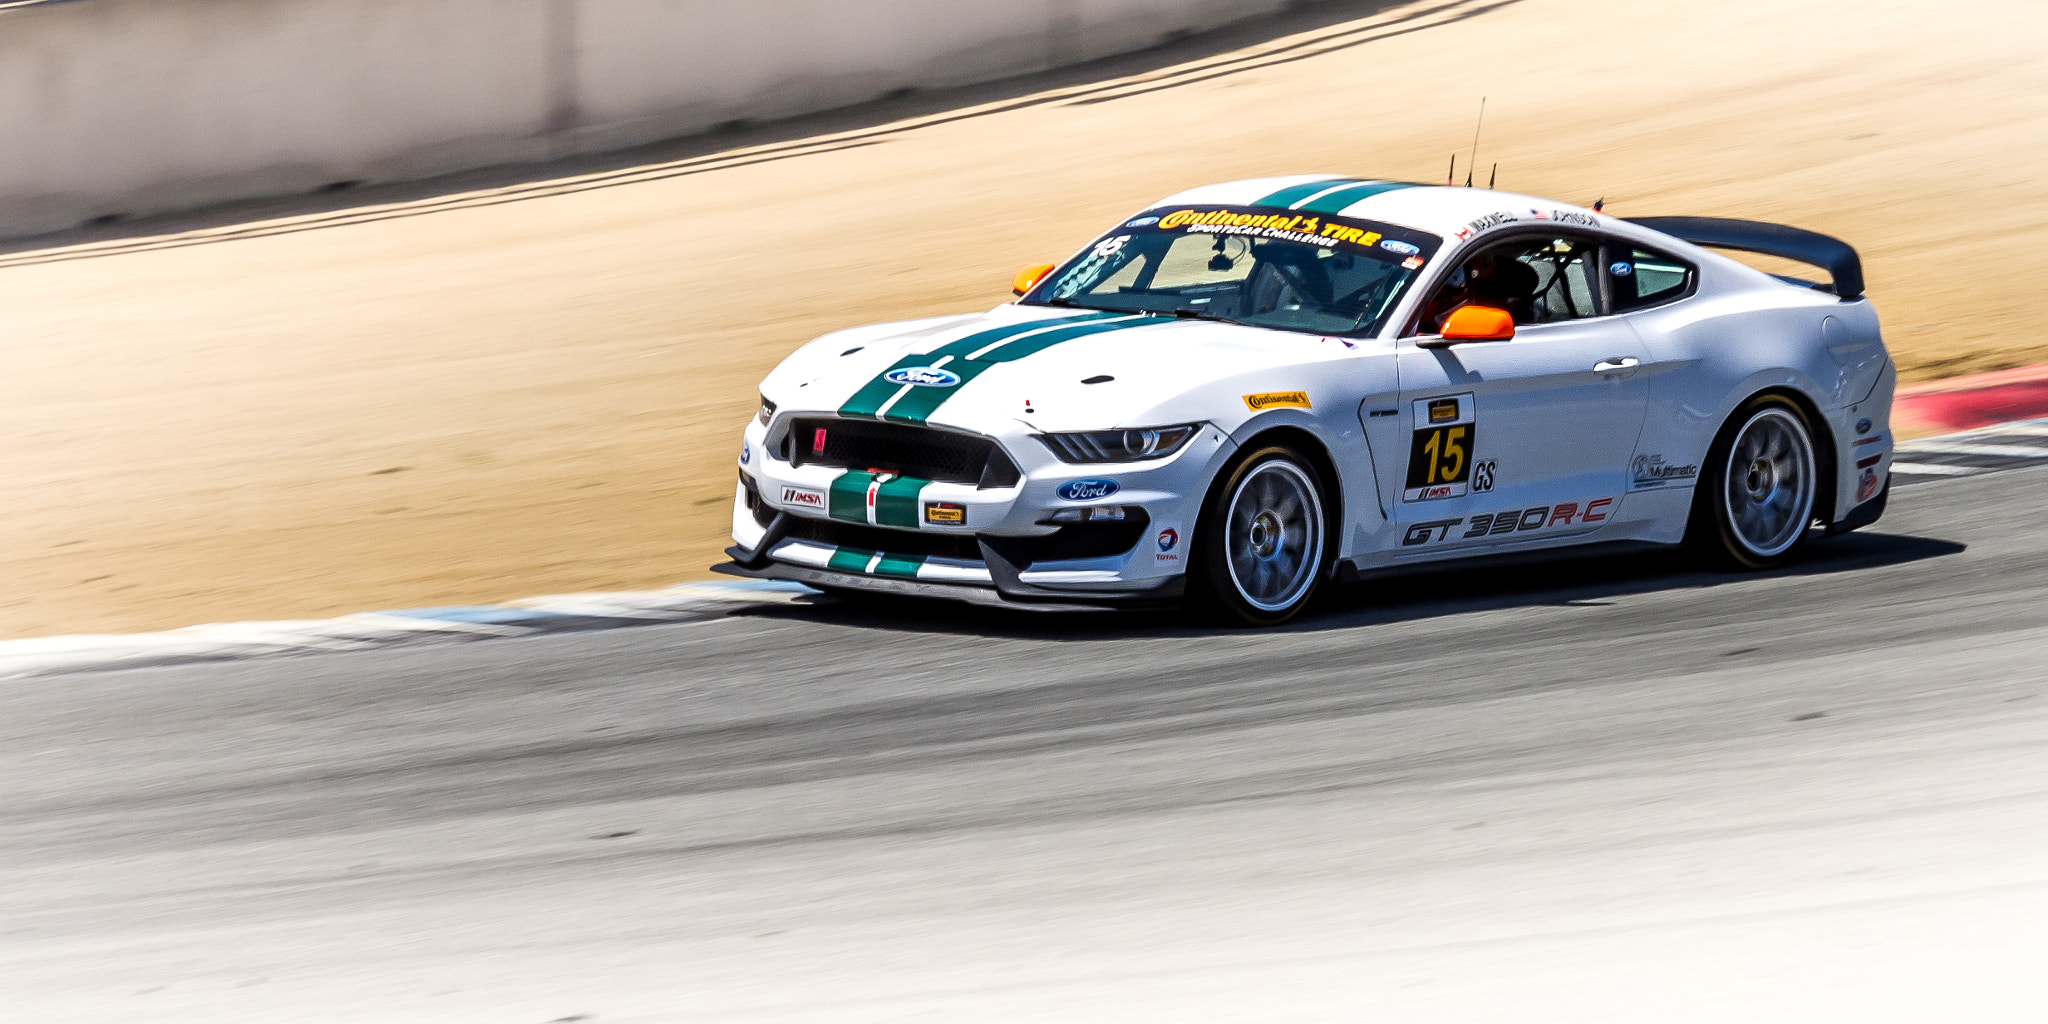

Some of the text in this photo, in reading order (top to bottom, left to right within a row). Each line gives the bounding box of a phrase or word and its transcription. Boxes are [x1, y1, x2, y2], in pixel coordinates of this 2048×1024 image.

[1158, 209, 1303, 231] Continental
[1321, 223, 1382, 247] TIRE
[1262, 227, 1340, 247] CHALLENGE
[1090, 235, 1131, 259] 15
[896, 369, 947, 384] Ford
[1424, 426, 1466, 484] 15
[1473, 461, 1496, 491] GS
[795, 492, 822, 505] IMSA
[1069, 480, 1108, 499] Ford
[1403, 518, 1463, 546] GT
[1156, 553, 1178, 561] TOTAL
